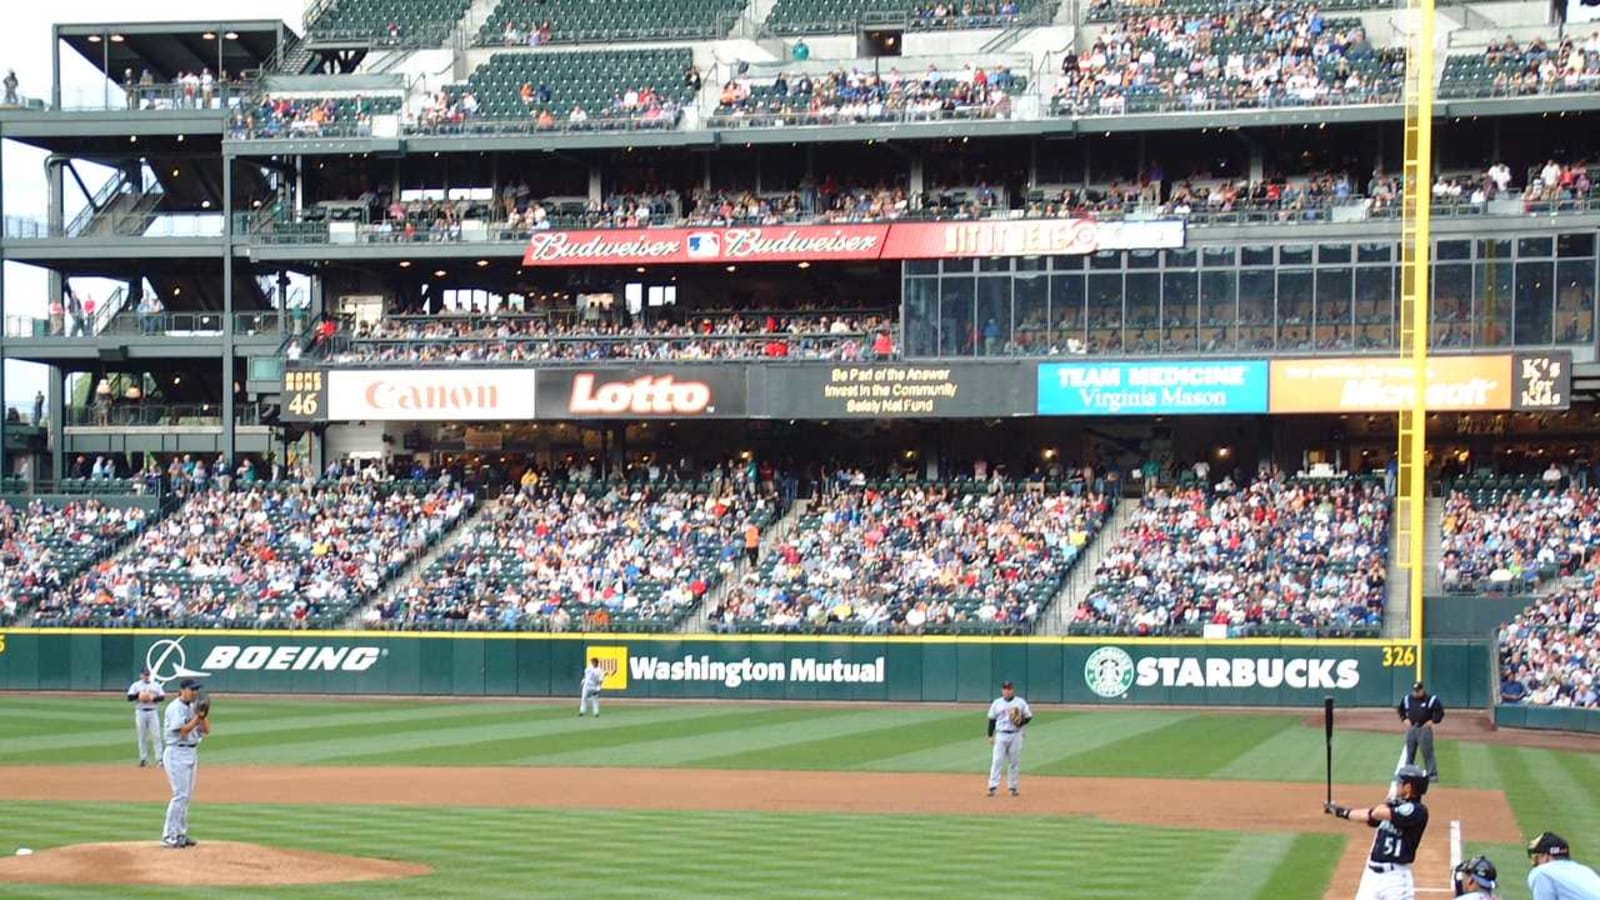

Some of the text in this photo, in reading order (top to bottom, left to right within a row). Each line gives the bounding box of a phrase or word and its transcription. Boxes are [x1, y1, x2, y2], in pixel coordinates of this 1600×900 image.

[530, 232, 680, 260] Budweiser
[724, 226, 877, 257] Budweiser
[831, 368, 848, 382] Be
[874, 368, 887, 381] of
[887, 368, 905, 380] the
[906, 368, 950, 380] Answer
[1058, 366, 1245, 387] TEAM MEDICINE
[1521, 359, 1561, 378] K's
[365, 380, 499, 409] Canon
[568, 372, 712, 414] Lotto
[824, 384, 858, 397] Invest
[872, 384, 891, 396] the
[892, 383, 958, 398] Community
[1339, 378, 1496, 407] Micrsoft
[1528, 377, 1554, 395] for
[288, 393, 318, 415] 46
[903, 400, 934, 412] Fund
[1079, 388, 1227, 411] Virginia Mason
[1521, 391, 1561, 406] Kids
[202, 646, 380, 671] BOEING
[1382, 646, 1415, 667] 326
[629, 655, 885, 687] Washington Mutual
[1136, 657, 1360, 688] STARBUCKS
[1383, 836, 1402, 857] 51
